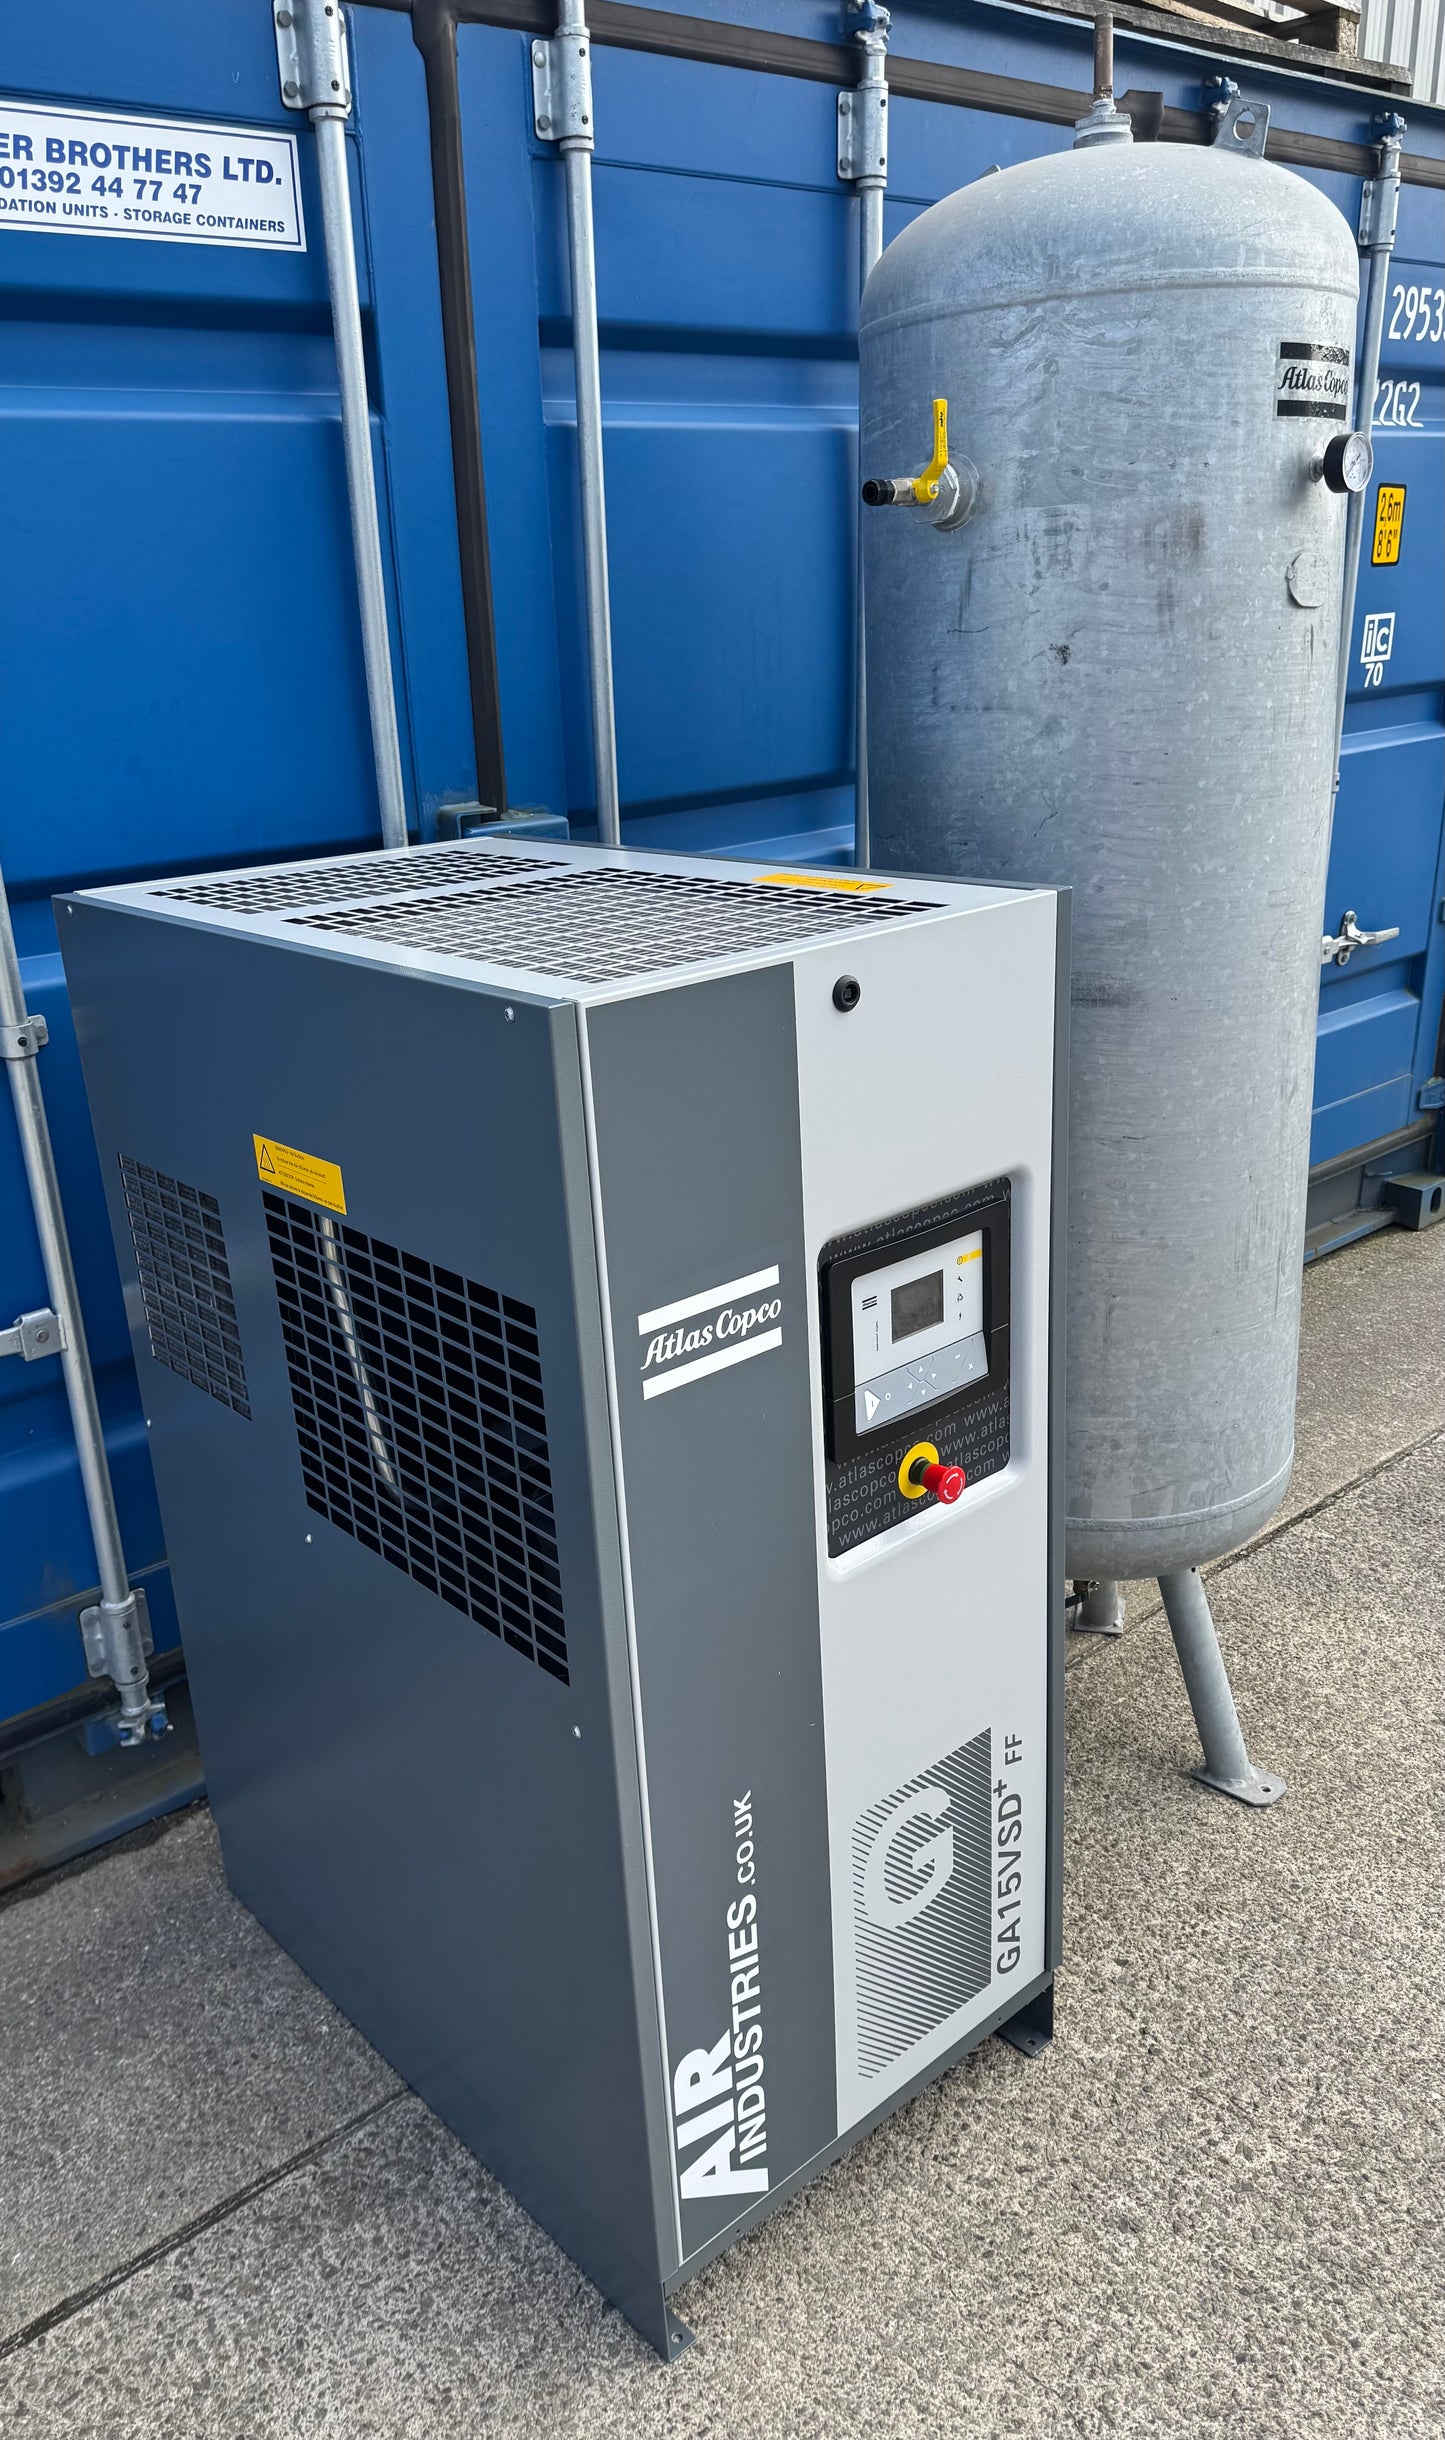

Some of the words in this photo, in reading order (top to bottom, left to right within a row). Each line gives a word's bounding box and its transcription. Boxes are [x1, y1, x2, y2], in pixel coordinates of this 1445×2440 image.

[46, 137, 213, 179] BROTHERS
[222, 156, 282, 186] LTD.
[0, 166, 81, 195] 01392
[91, 175, 124, 198] 44
[133, 178, 164, 202] 77
[172, 183, 203, 205] 47
[62, 202, 109, 218] UNITS
[123, 207, 192, 226] STORAGE
[196, 213, 286, 233] CONTAINERS
[1388, 284, 1445, 343] 2953
[1277, 366, 1323, 392] Atlas
[1324, 369, 1349, 399] Copco
[1379, 492, 1401, 527] 2,6m
[1363, 662, 1384, 688] 70
[640, 1323, 713, 1371] Atlas
[715, 1298, 782, 1337] Copco
[827, 1490, 896, 1536] pco.com
[1004, 1733, 1023, 1767] FF
[732, 1789, 757, 1886] .CO.UK
[726, 1893, 768, 2165] INDUSTRIES
[673, 2028, 769, 2200] AIR
